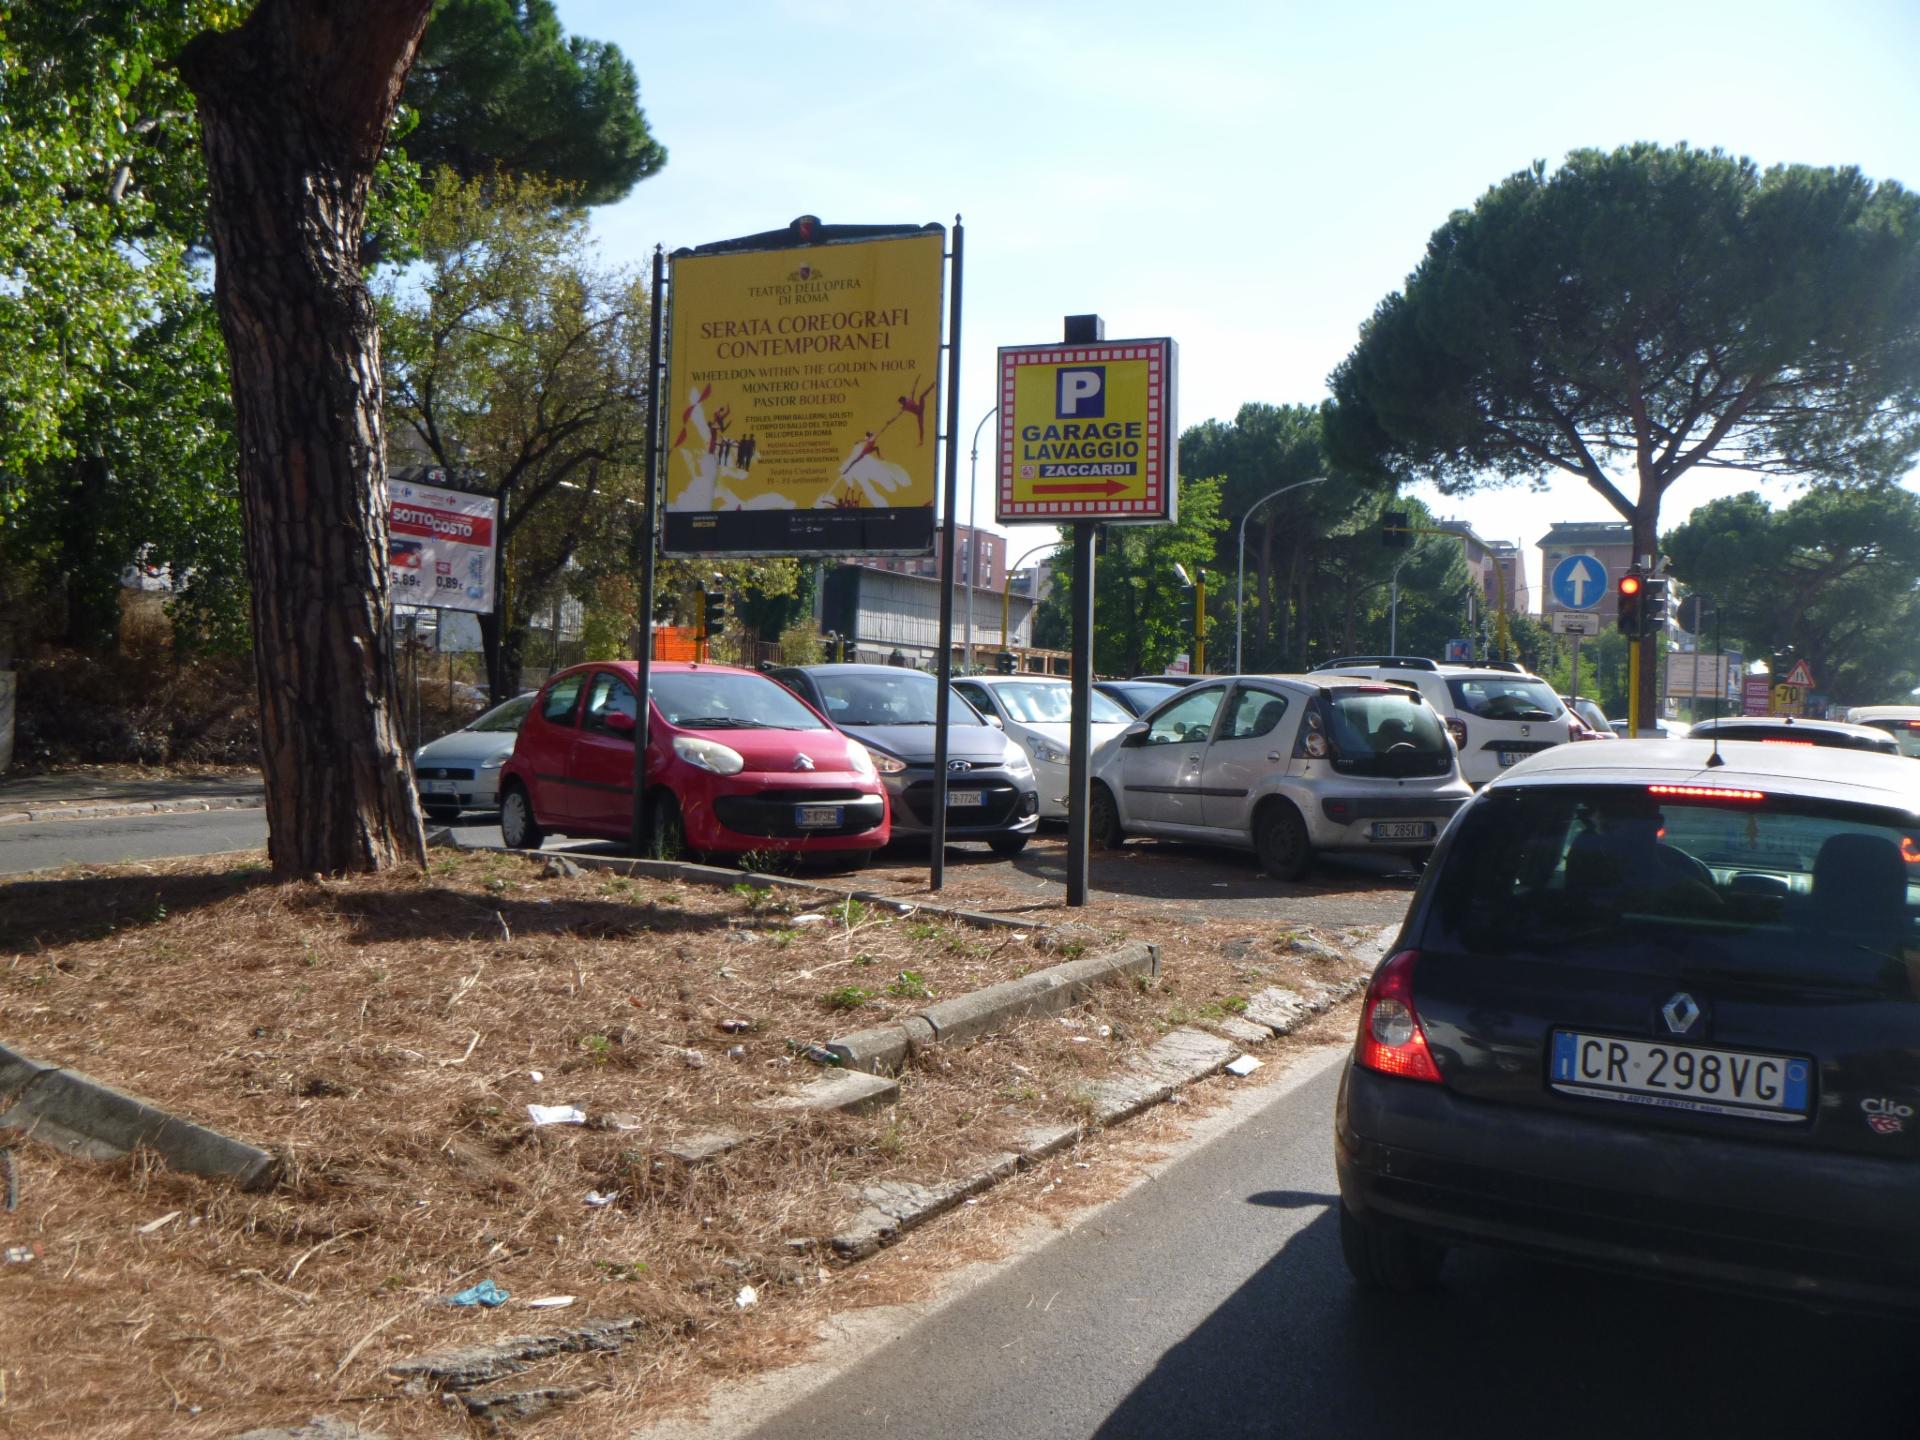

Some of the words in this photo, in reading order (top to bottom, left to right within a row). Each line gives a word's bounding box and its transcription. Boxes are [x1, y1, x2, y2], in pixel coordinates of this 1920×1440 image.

[748, 284, 792, 298] TEATRO
[795, 279, 861, 295] DELL'OPERA
[778, 295, 792, 306] DI
[795, 293, 829, 305] ROMA
[701, 318, 773, 340] SERATA
[778, 308, 909, 335] COREOGRAFI
[716, 332, 890, 360] CONTEMPORANEI
[691, 368, 756, 382] WHEELDON
[759, 365, 800, 379] WITHIN
[803, 363, 825, 376] THE
[828, 360, 878, 375] GOLDEN
[881, 359, 916, 371] HOUR
[742, 381, 799, 394] MONTERO
[802, 378, 860, 391] CHACONA
[1061, 371, 1100, 415] P
[753, 396, 797, 408] PASTOR
[800, 393, 846, 406] BOLERO
[1022, 422, 1142, 442] GARAGE
[1024, 441, 1140, 461] LAVAGGIO
[1044, 464, 1130, 477] ZACCARDI
